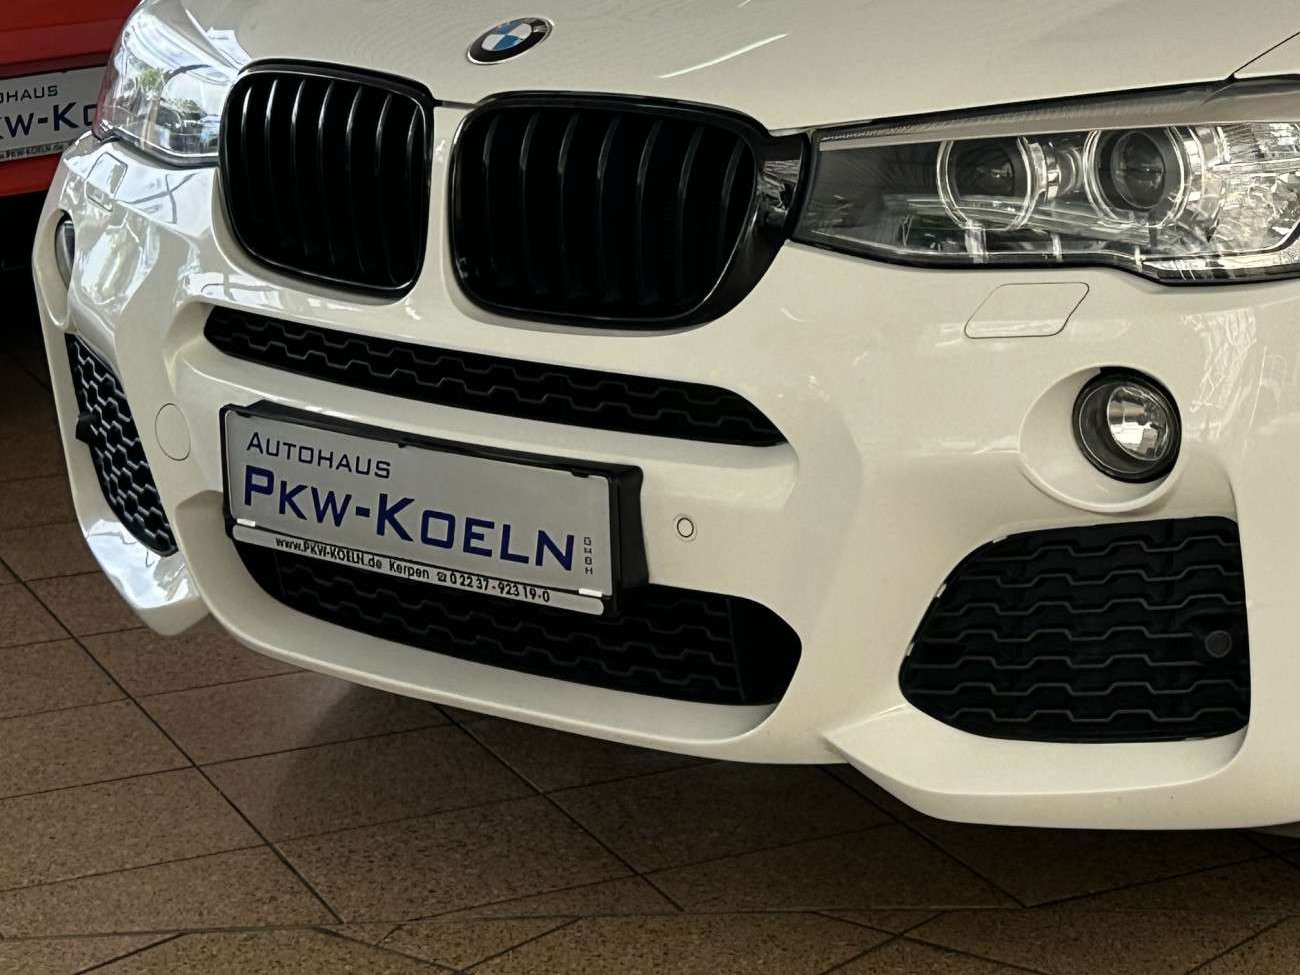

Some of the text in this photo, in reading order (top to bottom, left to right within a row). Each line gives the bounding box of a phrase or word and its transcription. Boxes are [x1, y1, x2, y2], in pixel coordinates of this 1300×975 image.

[246, 431, 391, 479] AUTOHAUS
[243, 464, 575, 571] PKW-KOELN
[389, 558, 430, 580] Kerpen
